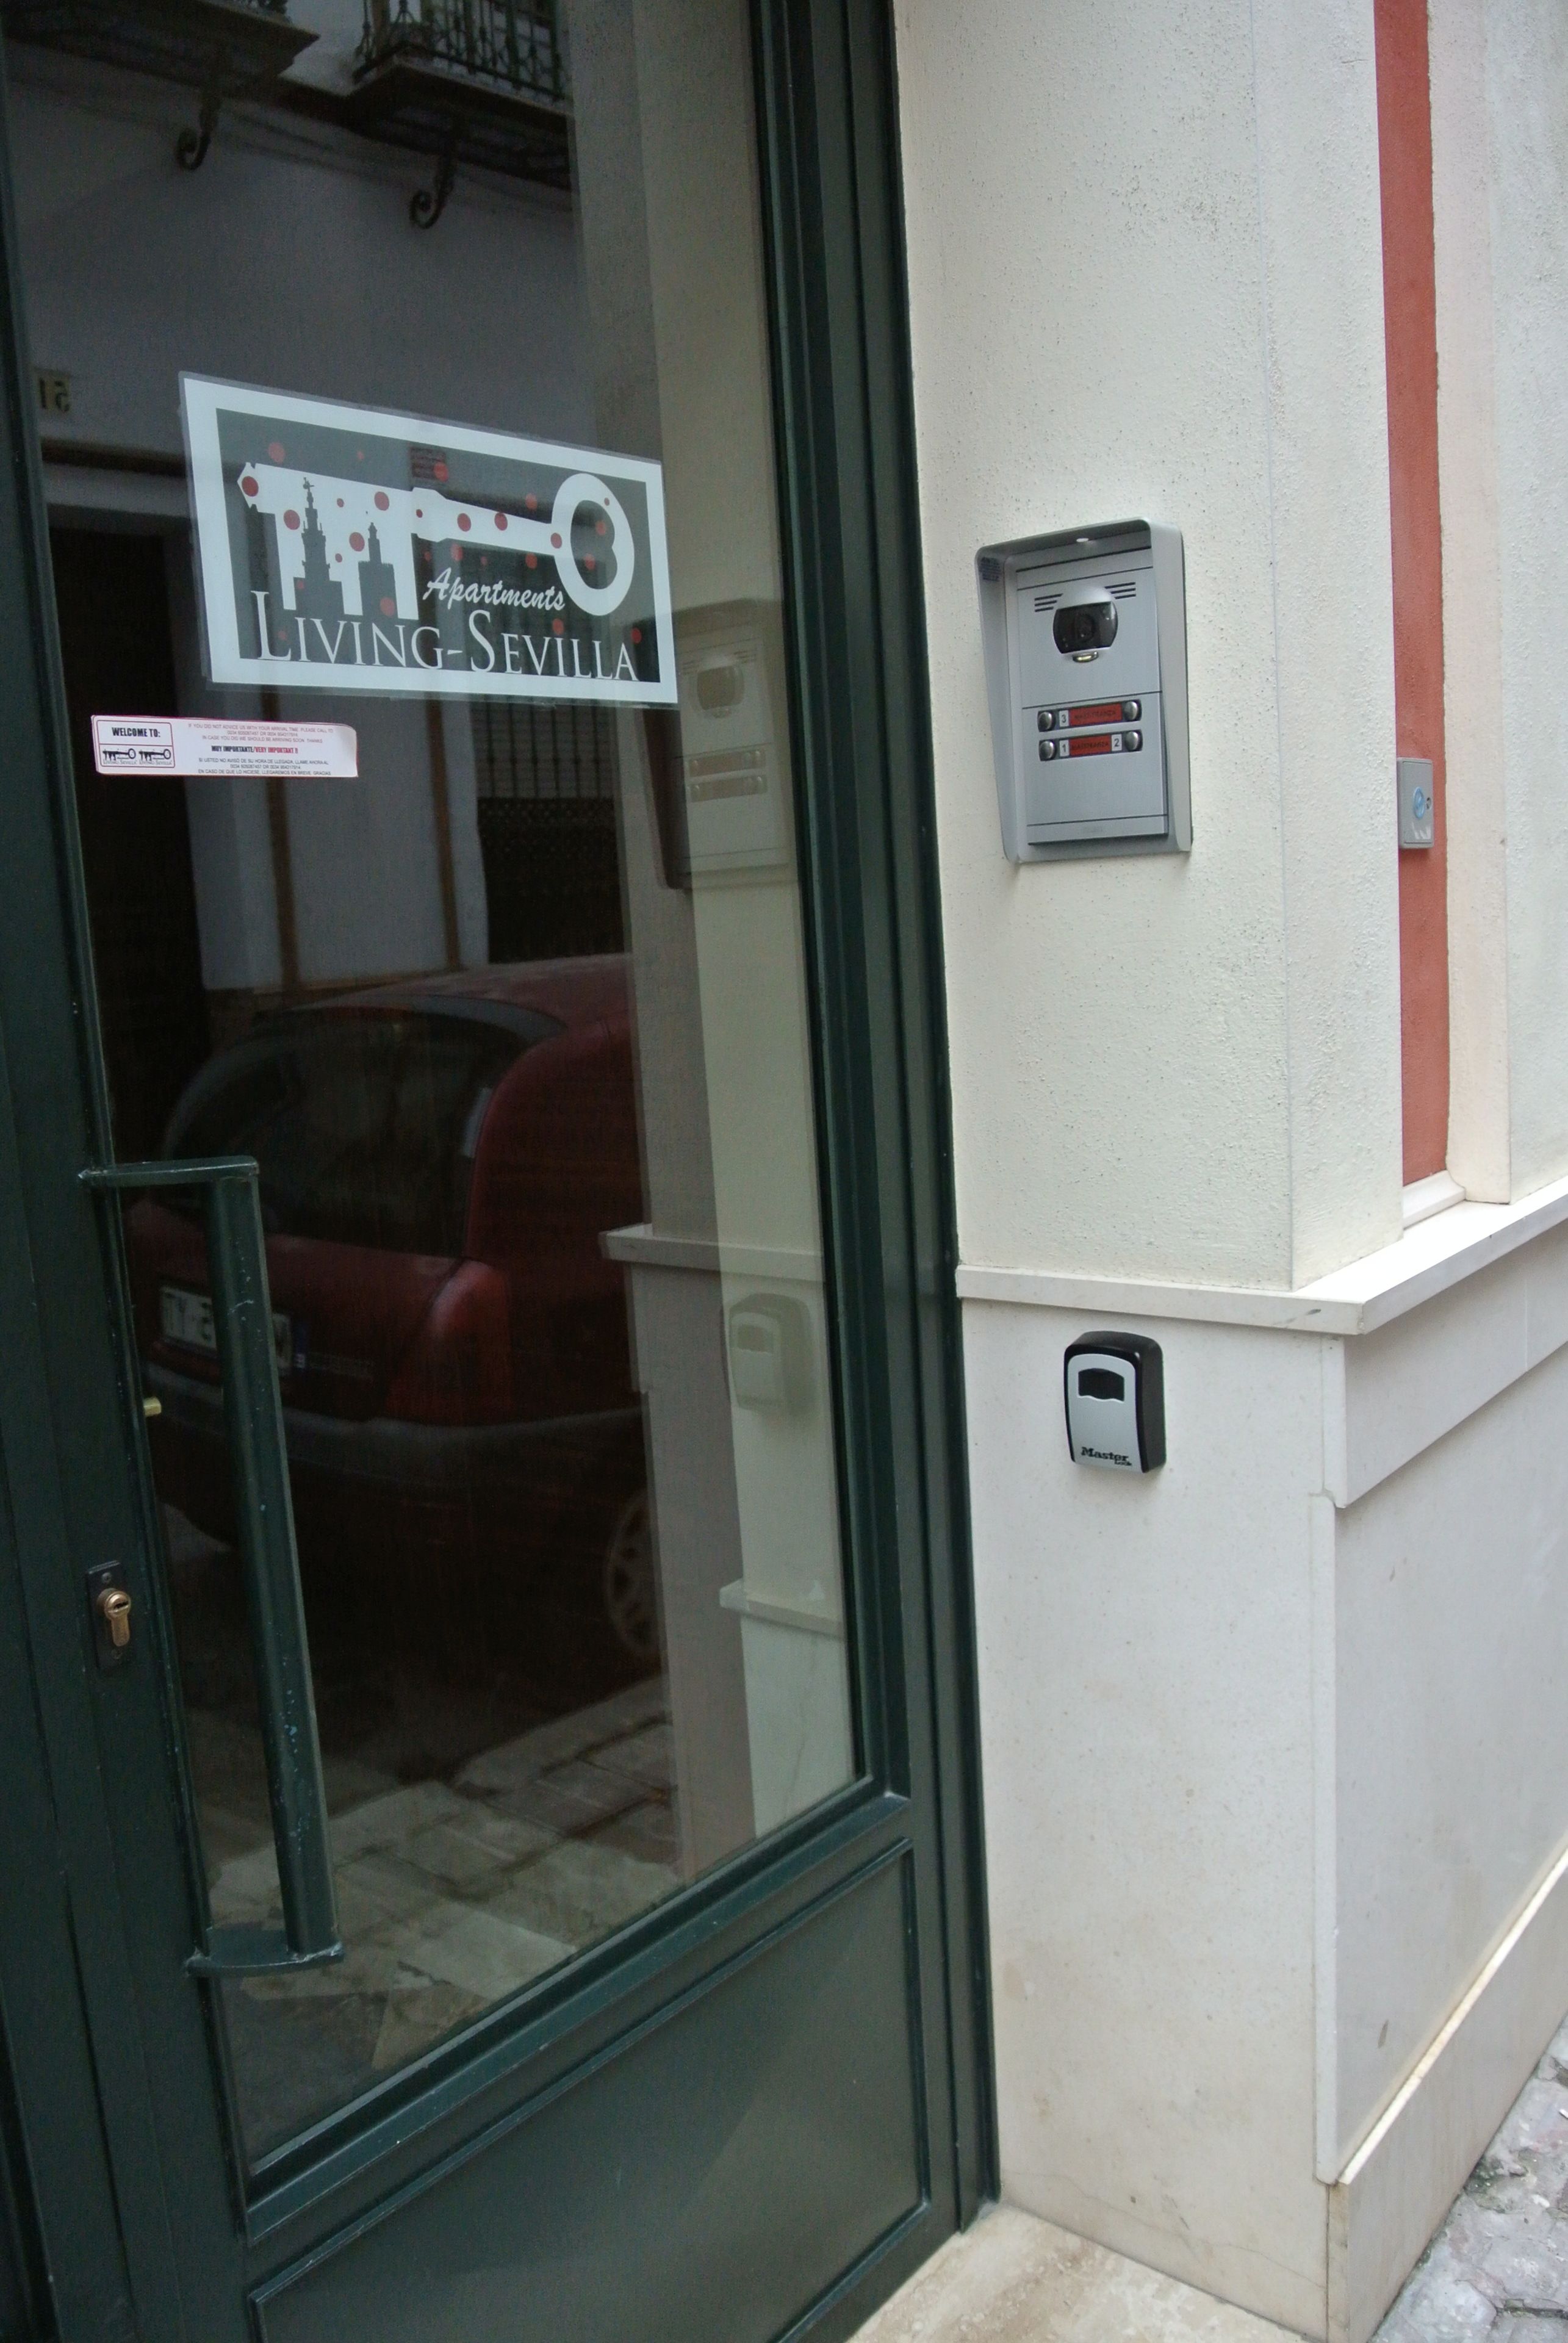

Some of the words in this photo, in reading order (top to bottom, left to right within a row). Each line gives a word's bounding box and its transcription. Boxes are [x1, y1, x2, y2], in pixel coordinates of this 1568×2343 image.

[422, 567, 566, 612] Apartments
[251, 590, 639, 682] LIVING-SEVILLA
[1062, 714, 1066, 723] 3
[112, 727, 148, 737] WELCOME
[149, 729, 160, 738] TO:
[1062, 744, 1066, 752] 1
[1114, 738, 1120, 747] 2
[1081, 1446, 1129, 1461] Master
